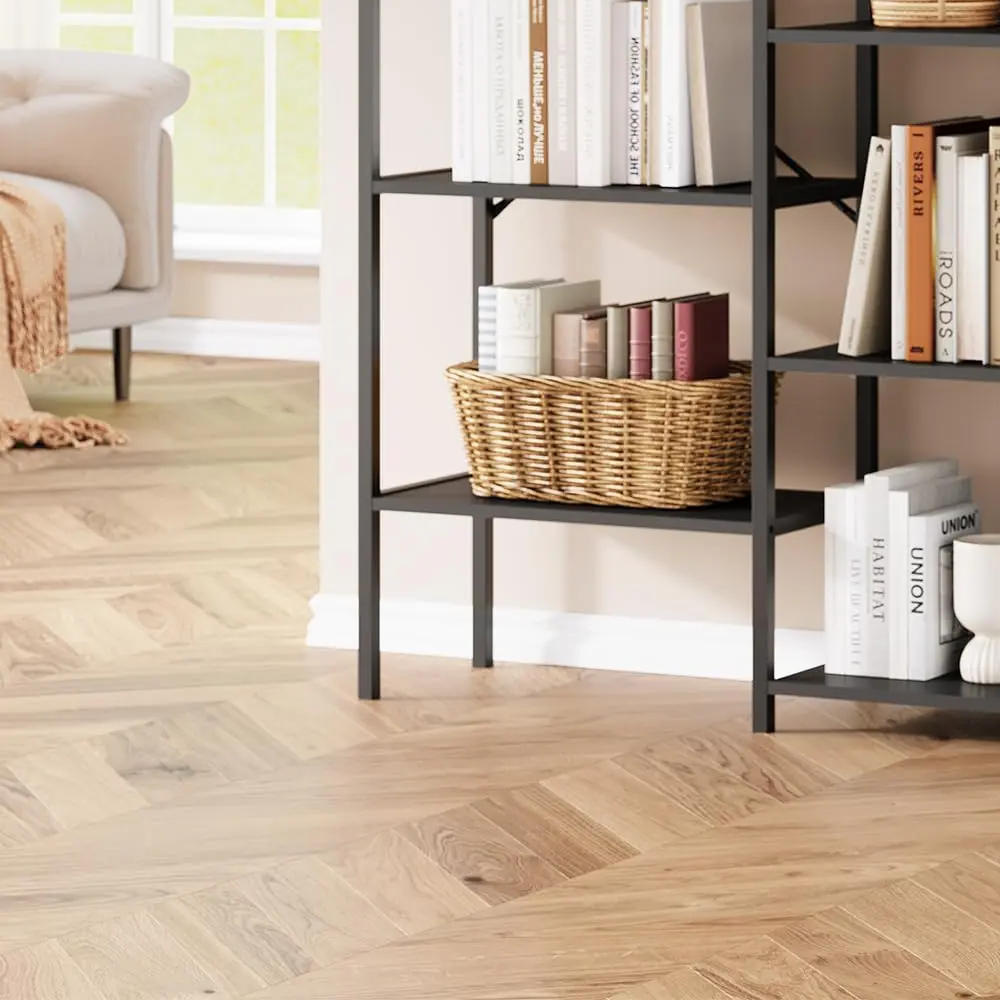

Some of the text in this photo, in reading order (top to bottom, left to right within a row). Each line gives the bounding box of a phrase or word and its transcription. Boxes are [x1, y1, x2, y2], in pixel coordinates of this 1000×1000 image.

[912, 150, 925, 217] RIVERS
[939, 257, 953, 339] ROADS
[941, 513, 976, 535] UNION
[872, 537, 885, 623] HABITAT
[910, 547, 925, 614] UNION
